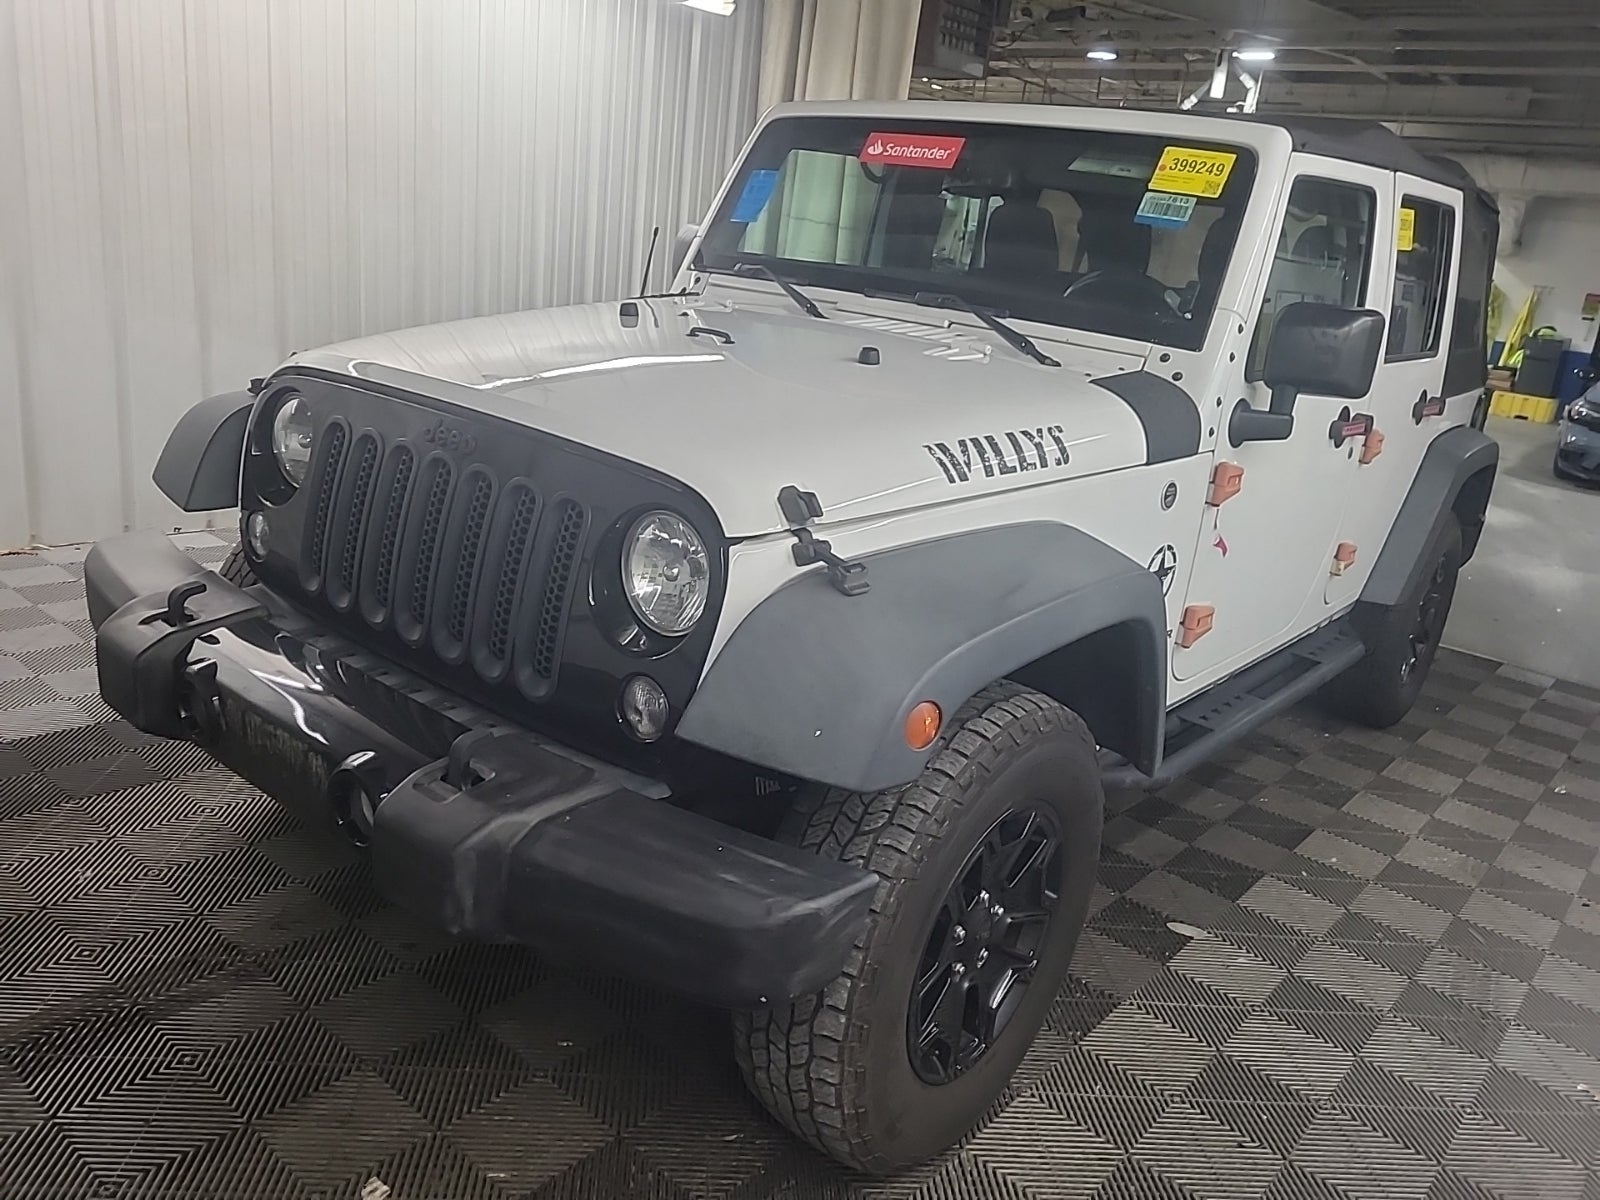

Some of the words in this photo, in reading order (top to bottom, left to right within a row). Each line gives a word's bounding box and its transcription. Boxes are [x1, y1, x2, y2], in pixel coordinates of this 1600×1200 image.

[883, 143, 952, 160] Santander
[1168, 157, 1226, 177] 399249
[423, 419, 479, 454] Jeep
[922, 425, 1070, 484] WILLYS
